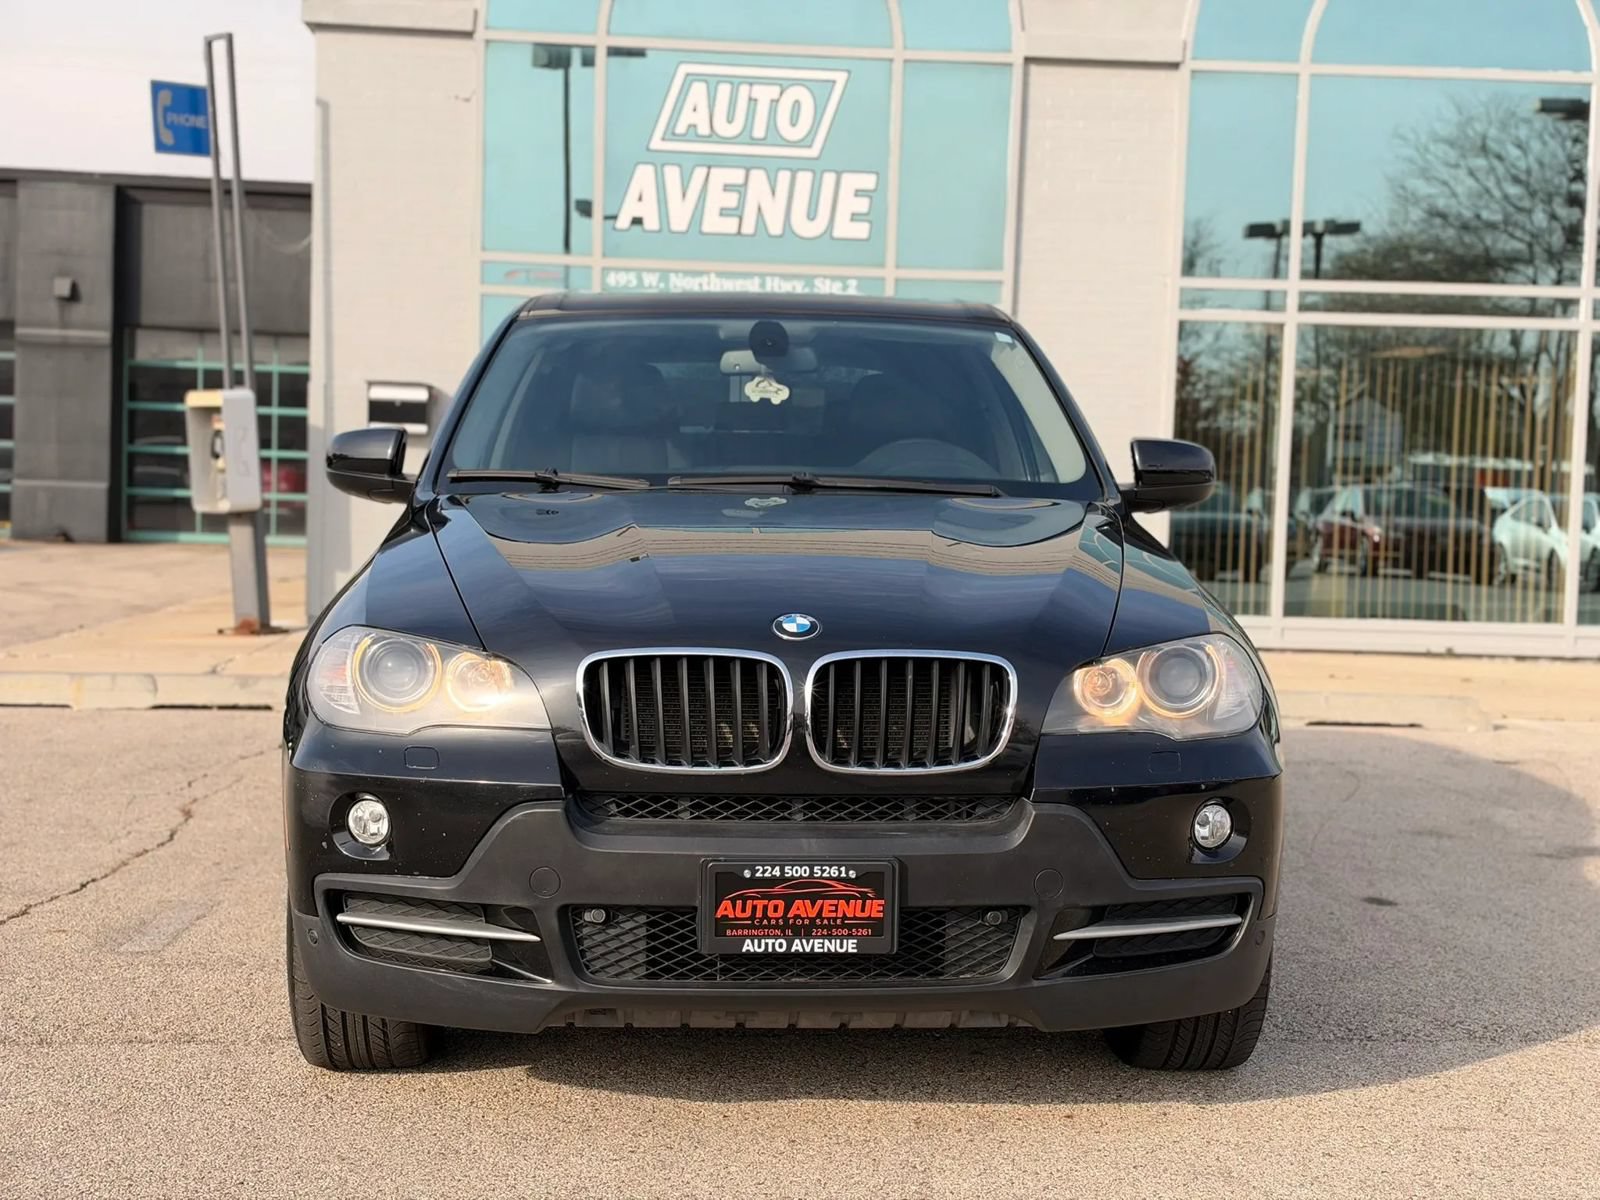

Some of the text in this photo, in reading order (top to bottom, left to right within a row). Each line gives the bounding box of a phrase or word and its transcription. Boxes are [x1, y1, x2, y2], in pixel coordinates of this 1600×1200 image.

[673, 80, 816, 143] AUTO
[614, 163, 879, 241] AVENUE
[606, 270, 638, 288] 495
[669, 272, 760, 293] Northwest
[755, 866, 847, 877] 224 500 5261
[715, 899, 885, 918] AUTO AVENUE
[726, 928, 872, 937] BARRINGTON, IL 224-500-5261
[741, 939, 857, 953] AUTO AVENUE
